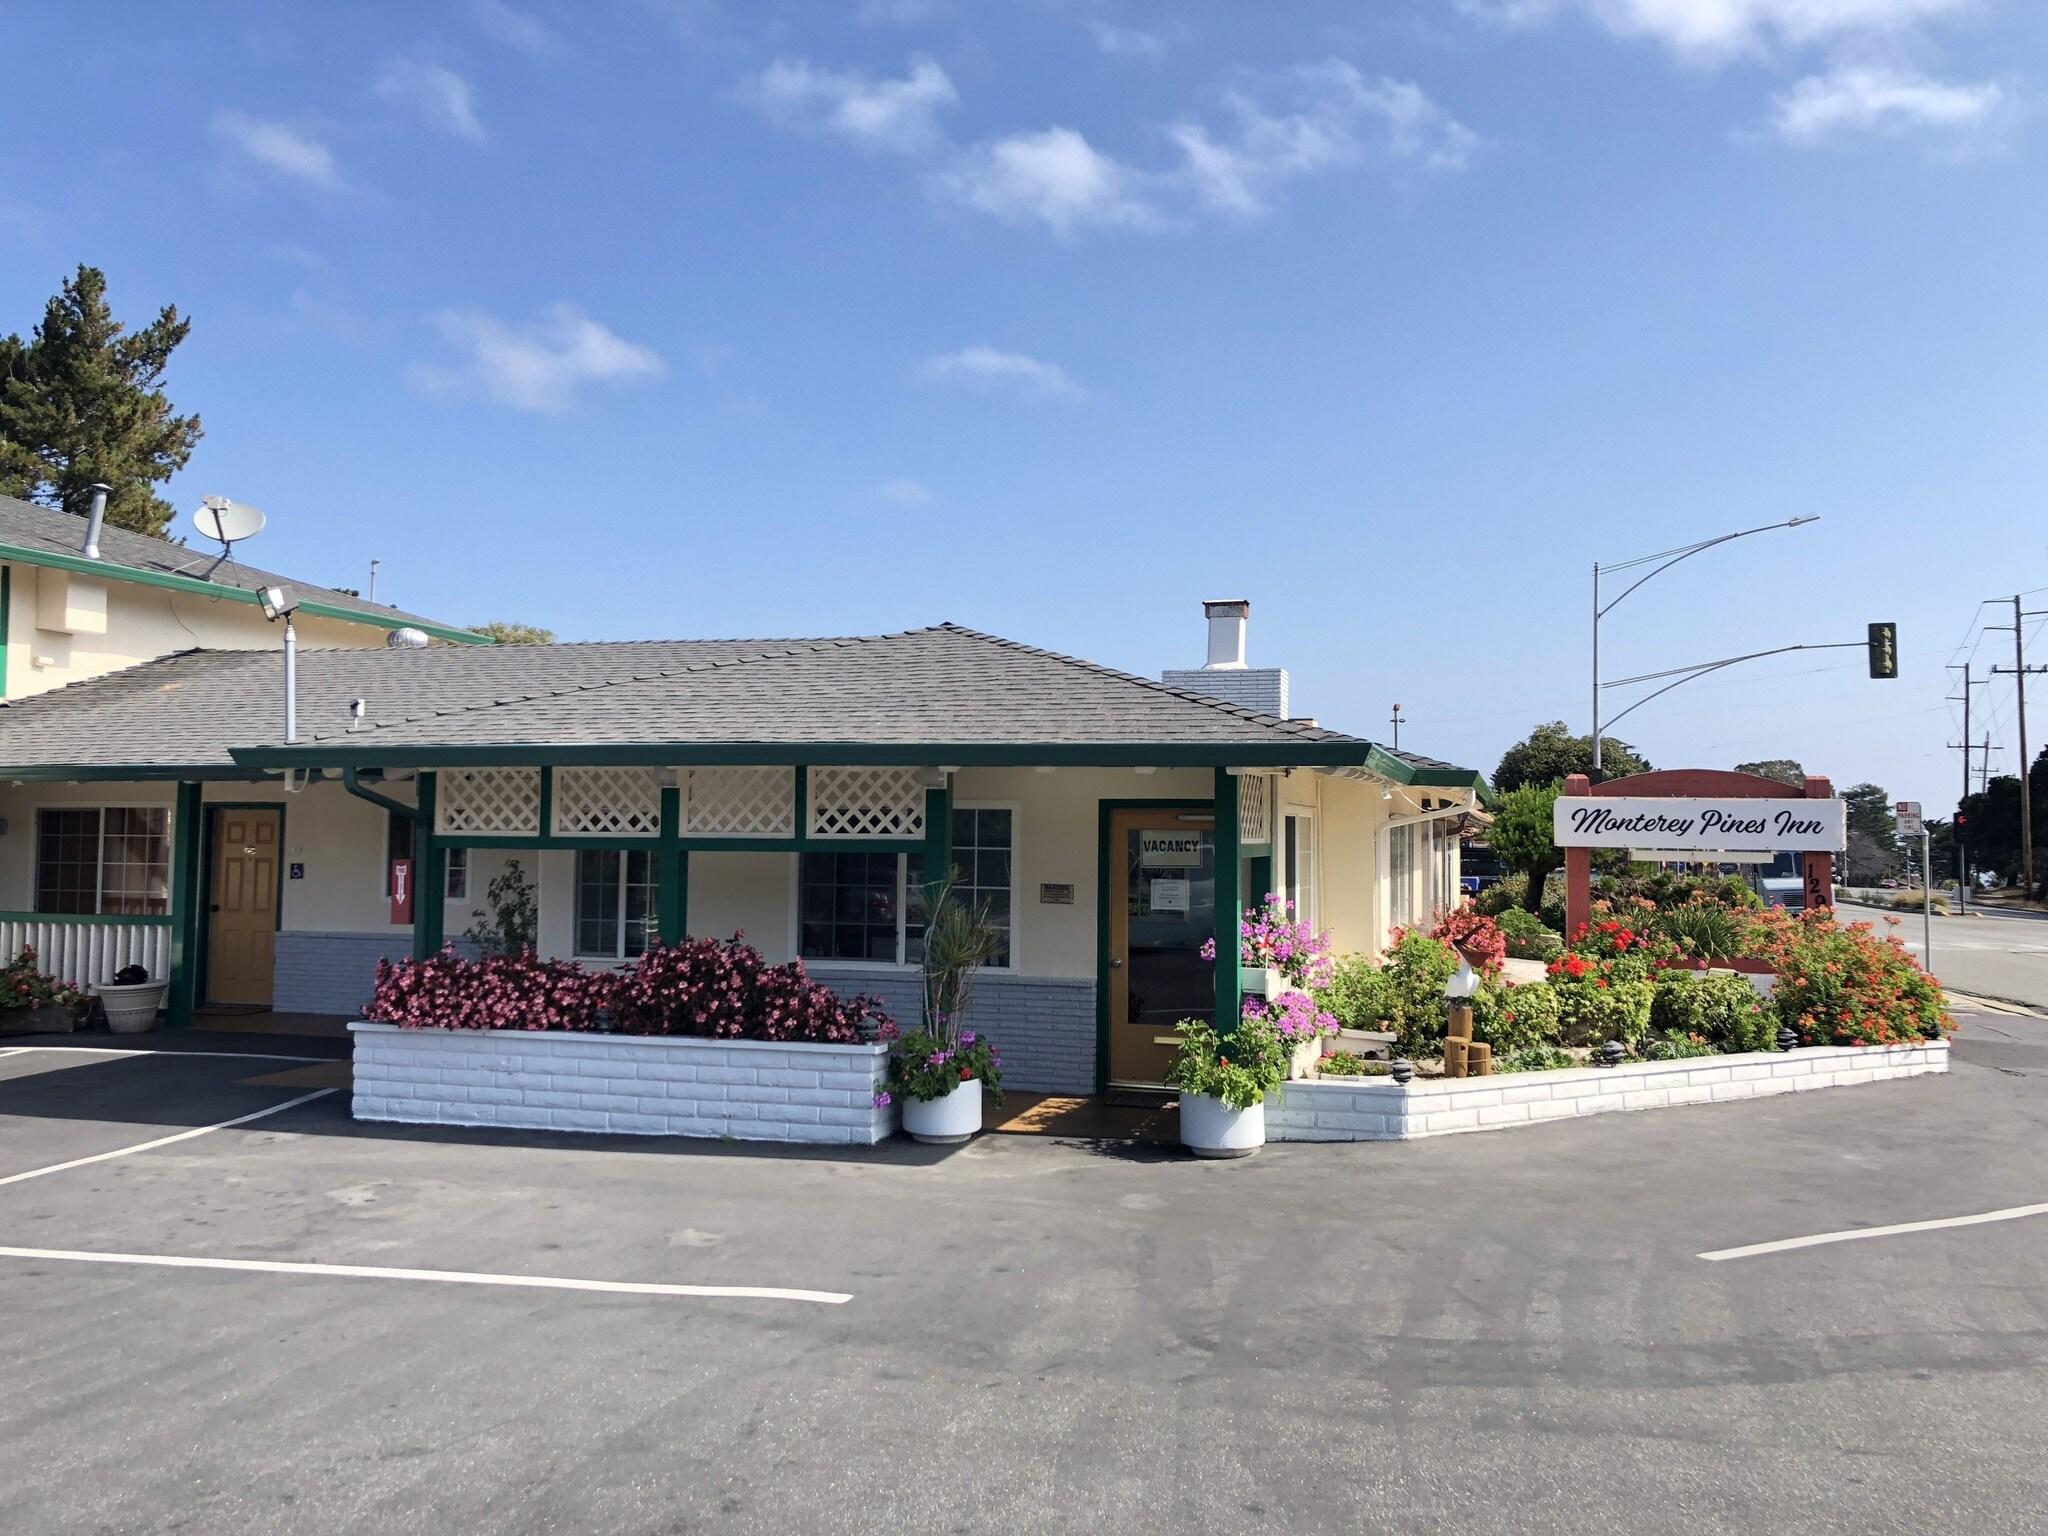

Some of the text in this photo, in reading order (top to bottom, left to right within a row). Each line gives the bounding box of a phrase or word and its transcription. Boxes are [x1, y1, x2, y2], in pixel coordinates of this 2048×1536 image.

[1571, 808, 1824, 836] Monterey Pines Inn
[1143, 840, 1199, 852] VACANCY
